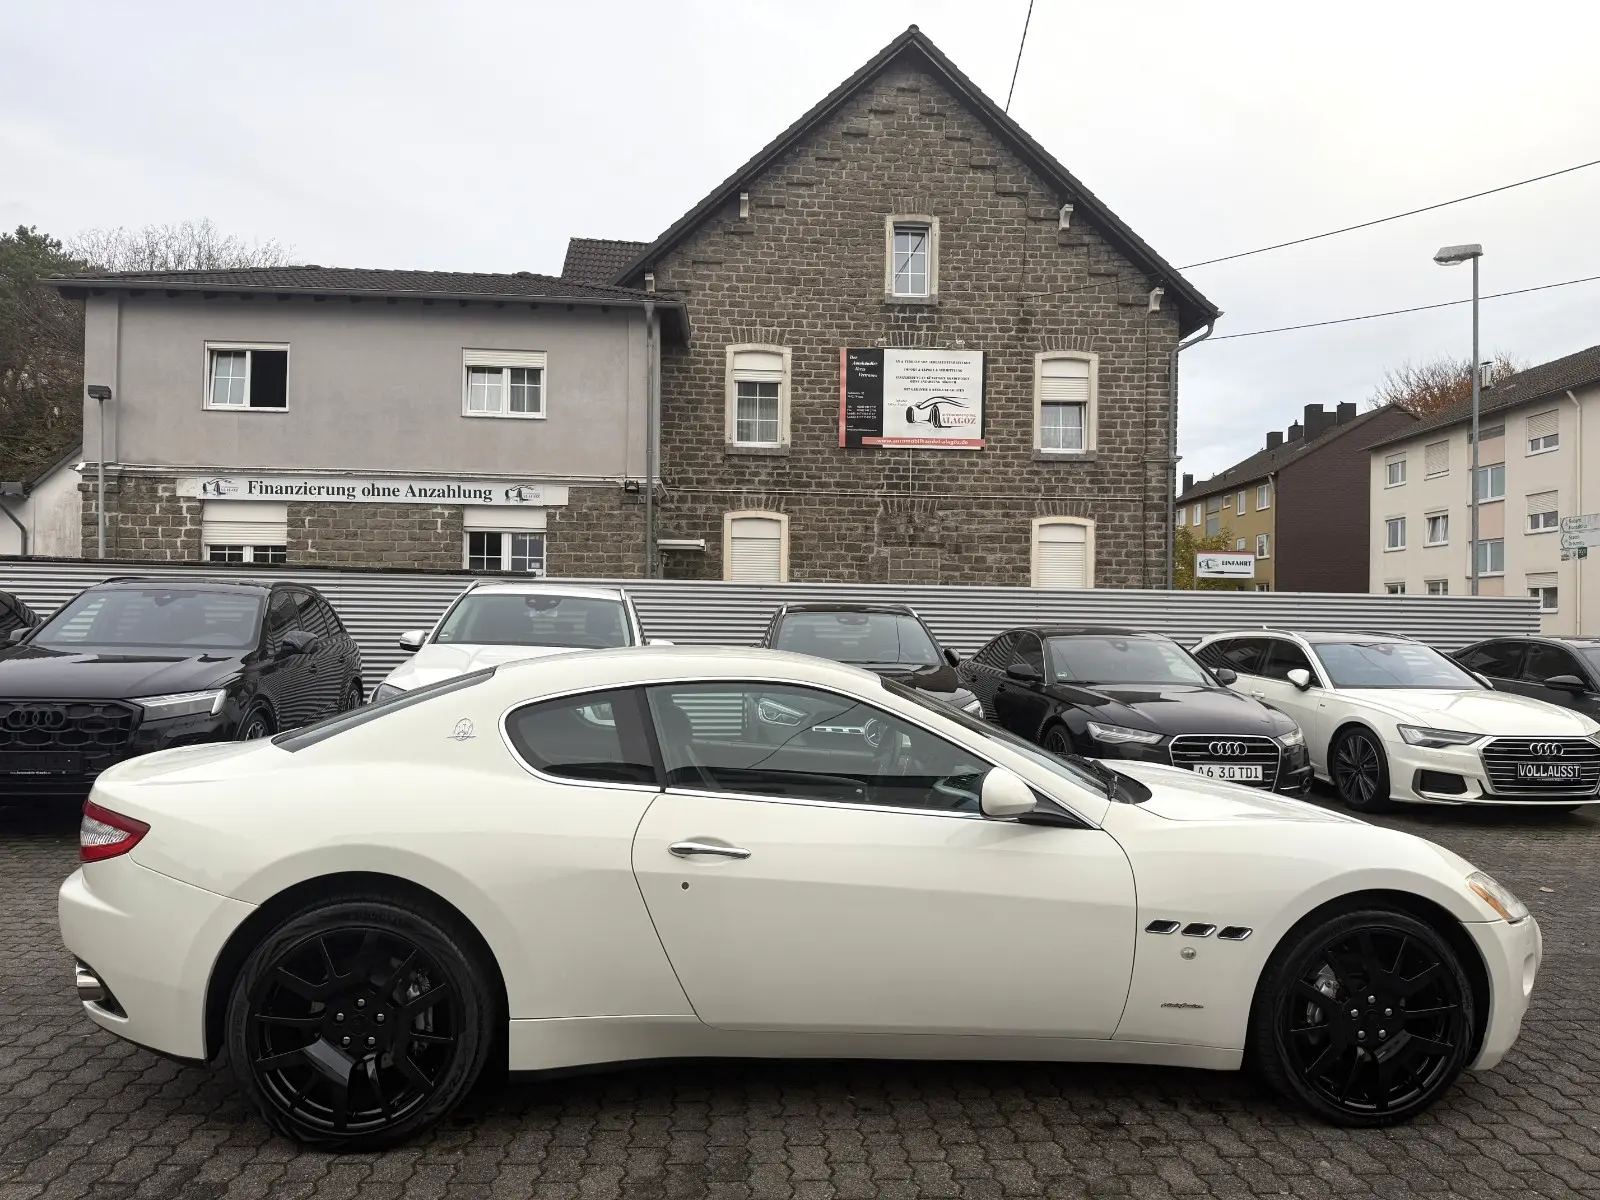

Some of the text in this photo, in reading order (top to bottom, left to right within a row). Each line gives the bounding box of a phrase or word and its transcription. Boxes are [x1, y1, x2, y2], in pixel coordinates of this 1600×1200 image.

[247, 480, 493, 502] Finanzierung ohne Anzahlung
[1237, 767, 1260, 779] TDI
[1519, 764, 1580, 778] VOLLAUSST
